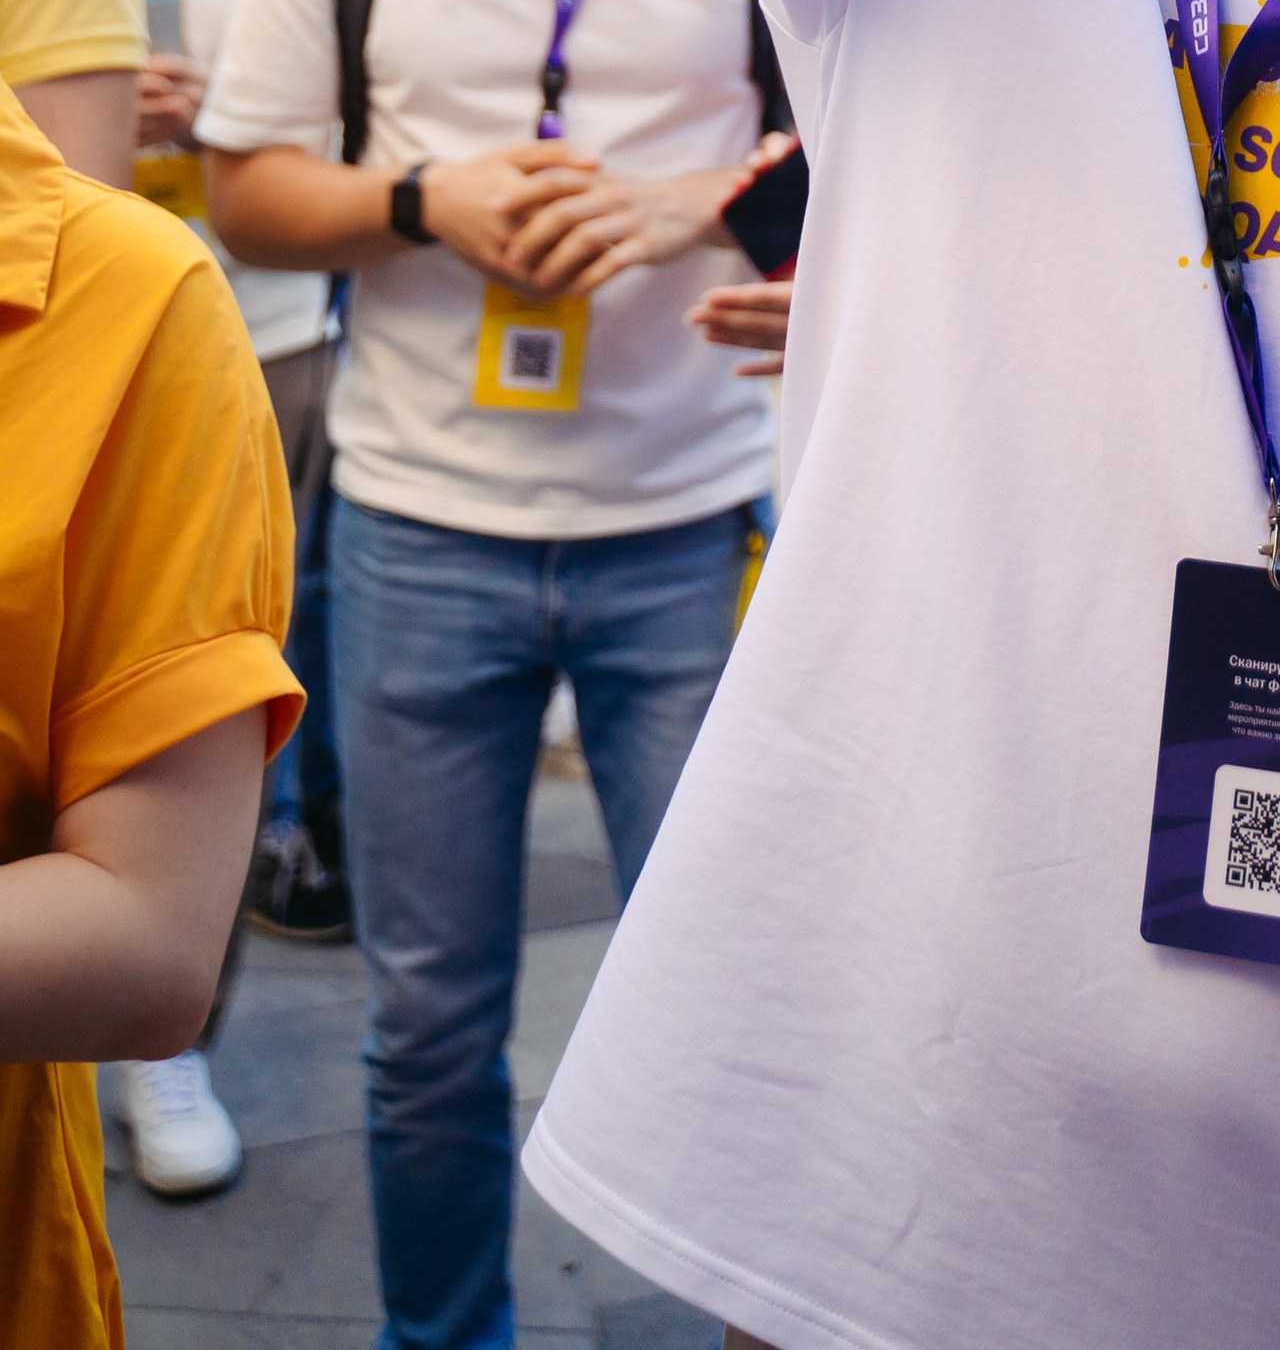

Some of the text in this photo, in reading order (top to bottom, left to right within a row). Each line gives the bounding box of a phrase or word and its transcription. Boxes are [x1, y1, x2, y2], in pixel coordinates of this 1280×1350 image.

[1234, 675, 1241, 685] в
[1245, 677, 1266, 689] чат
[1229, 701, 1253, 712] Здесь
